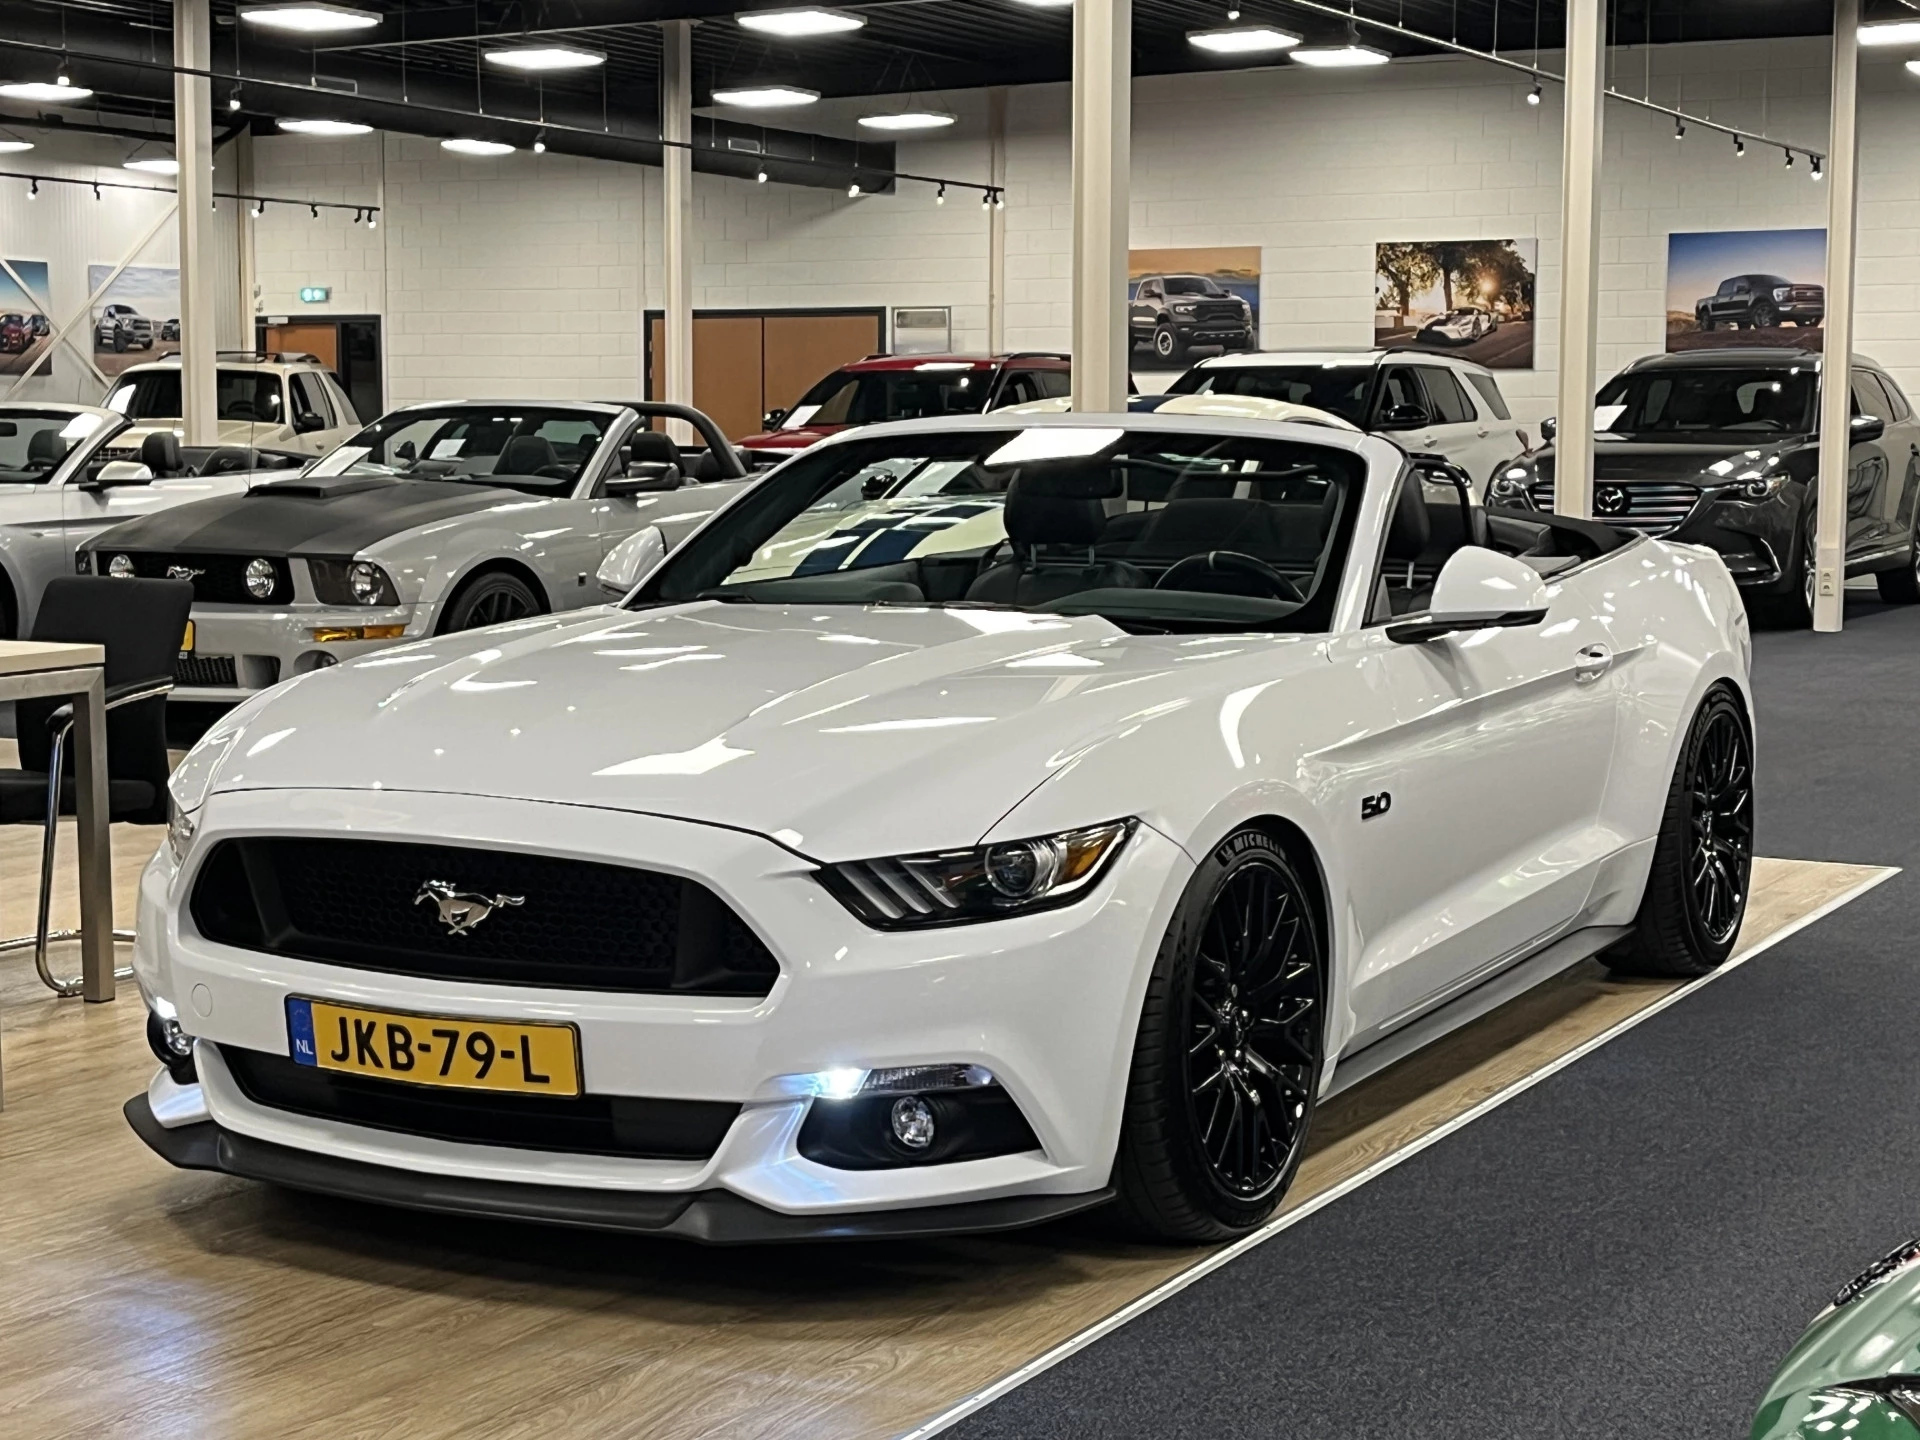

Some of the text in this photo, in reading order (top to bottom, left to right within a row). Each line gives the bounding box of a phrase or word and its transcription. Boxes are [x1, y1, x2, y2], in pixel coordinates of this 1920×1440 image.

[1233, 833, 1287, 862] MICHELIN
[296, 1037, 314, 1056] NL
[331, 1016, 551, 1084] JKB-79-L
